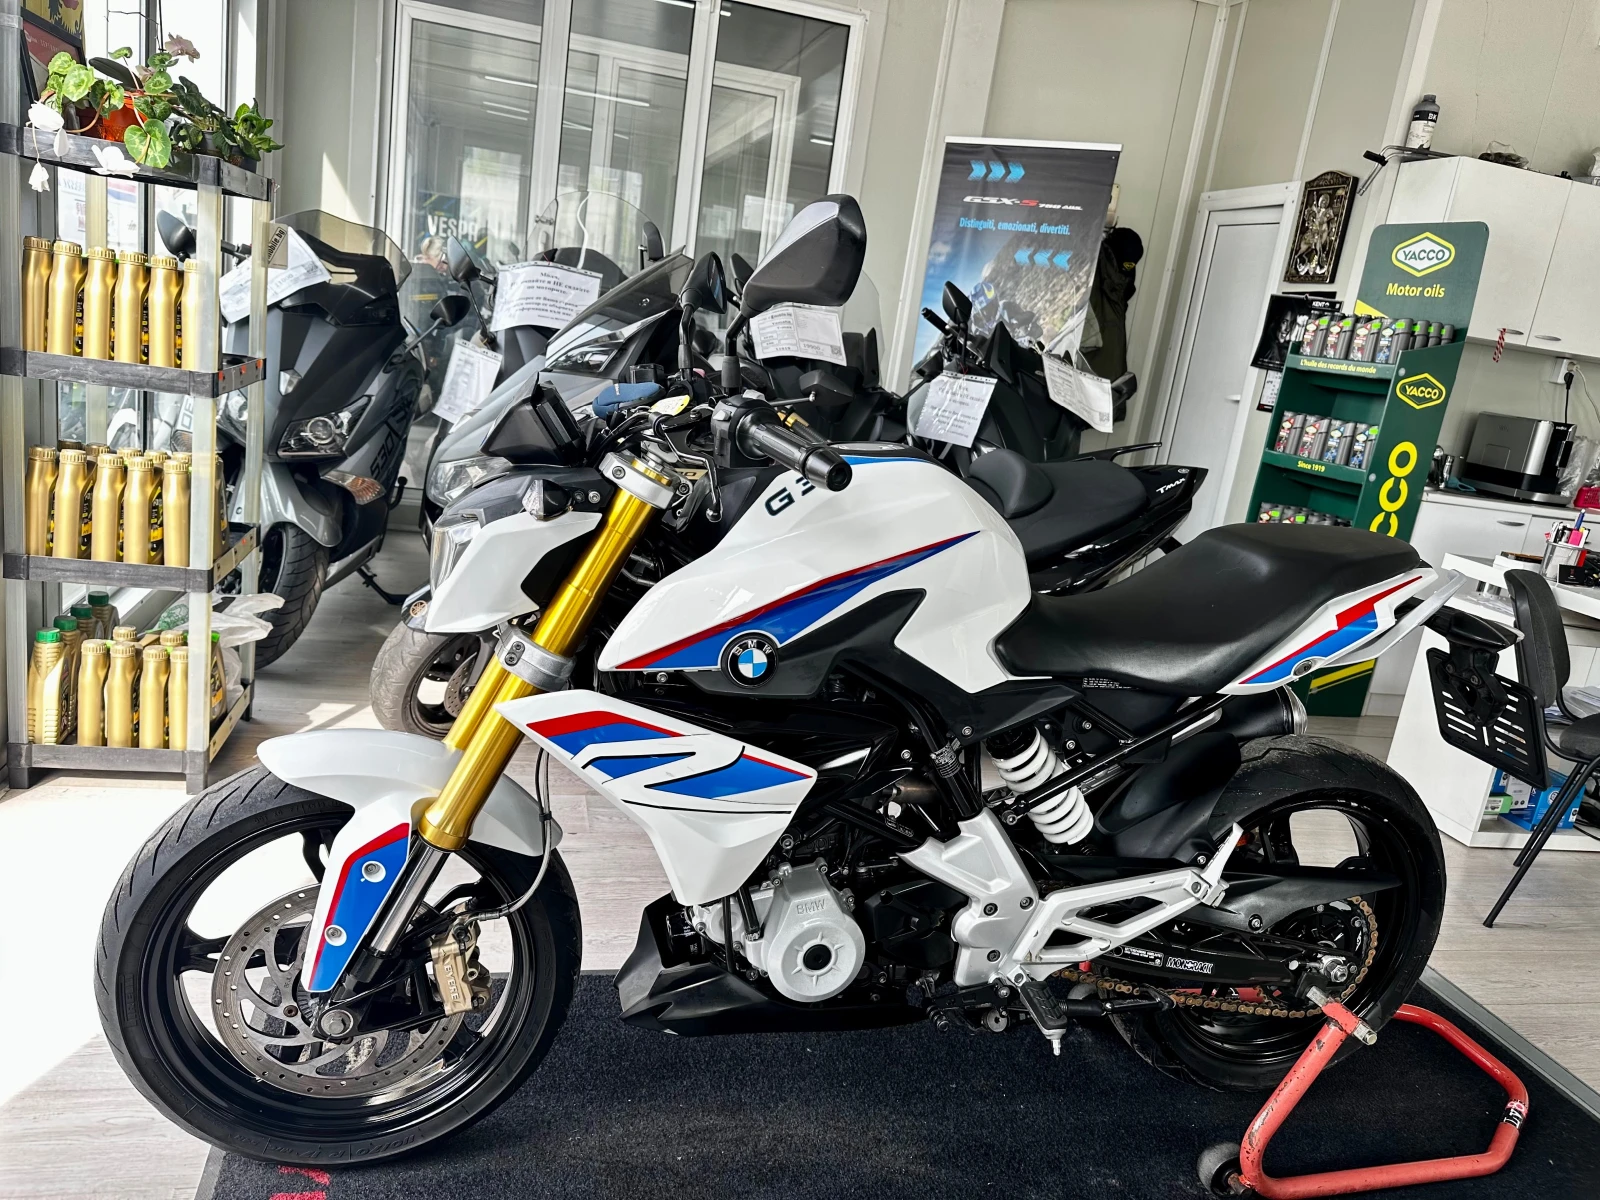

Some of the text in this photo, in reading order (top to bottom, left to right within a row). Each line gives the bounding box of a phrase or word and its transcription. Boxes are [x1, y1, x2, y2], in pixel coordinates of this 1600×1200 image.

[962, 195, 1039, 207] GSX-S
[427, 214, 479, 243] VESPA
[959, 217, 1071, 236] Distinguiti, emozionati, divertiti.
[1402, 248, 1446, 262] YACCO
[1386, 282, 1446, 298] Motor oils
[1317, 360, 1327, 369] des
[1327, 361, 1348, 371] records
[1348, 363, 1355, 372] du
[1355, 365, 1376, 374] monde
[1405, 384, 1439, 399] YACCO
[1297, 460, 1326, 473] Since 1919
[1369, 441, 1417, 538] CCO
[765, 486, 796, 516] G
[732, 639, 774, 656] BMW
[796, 899, 825, 915] BMW
[444, 964, 460, 1000] BYBRE
